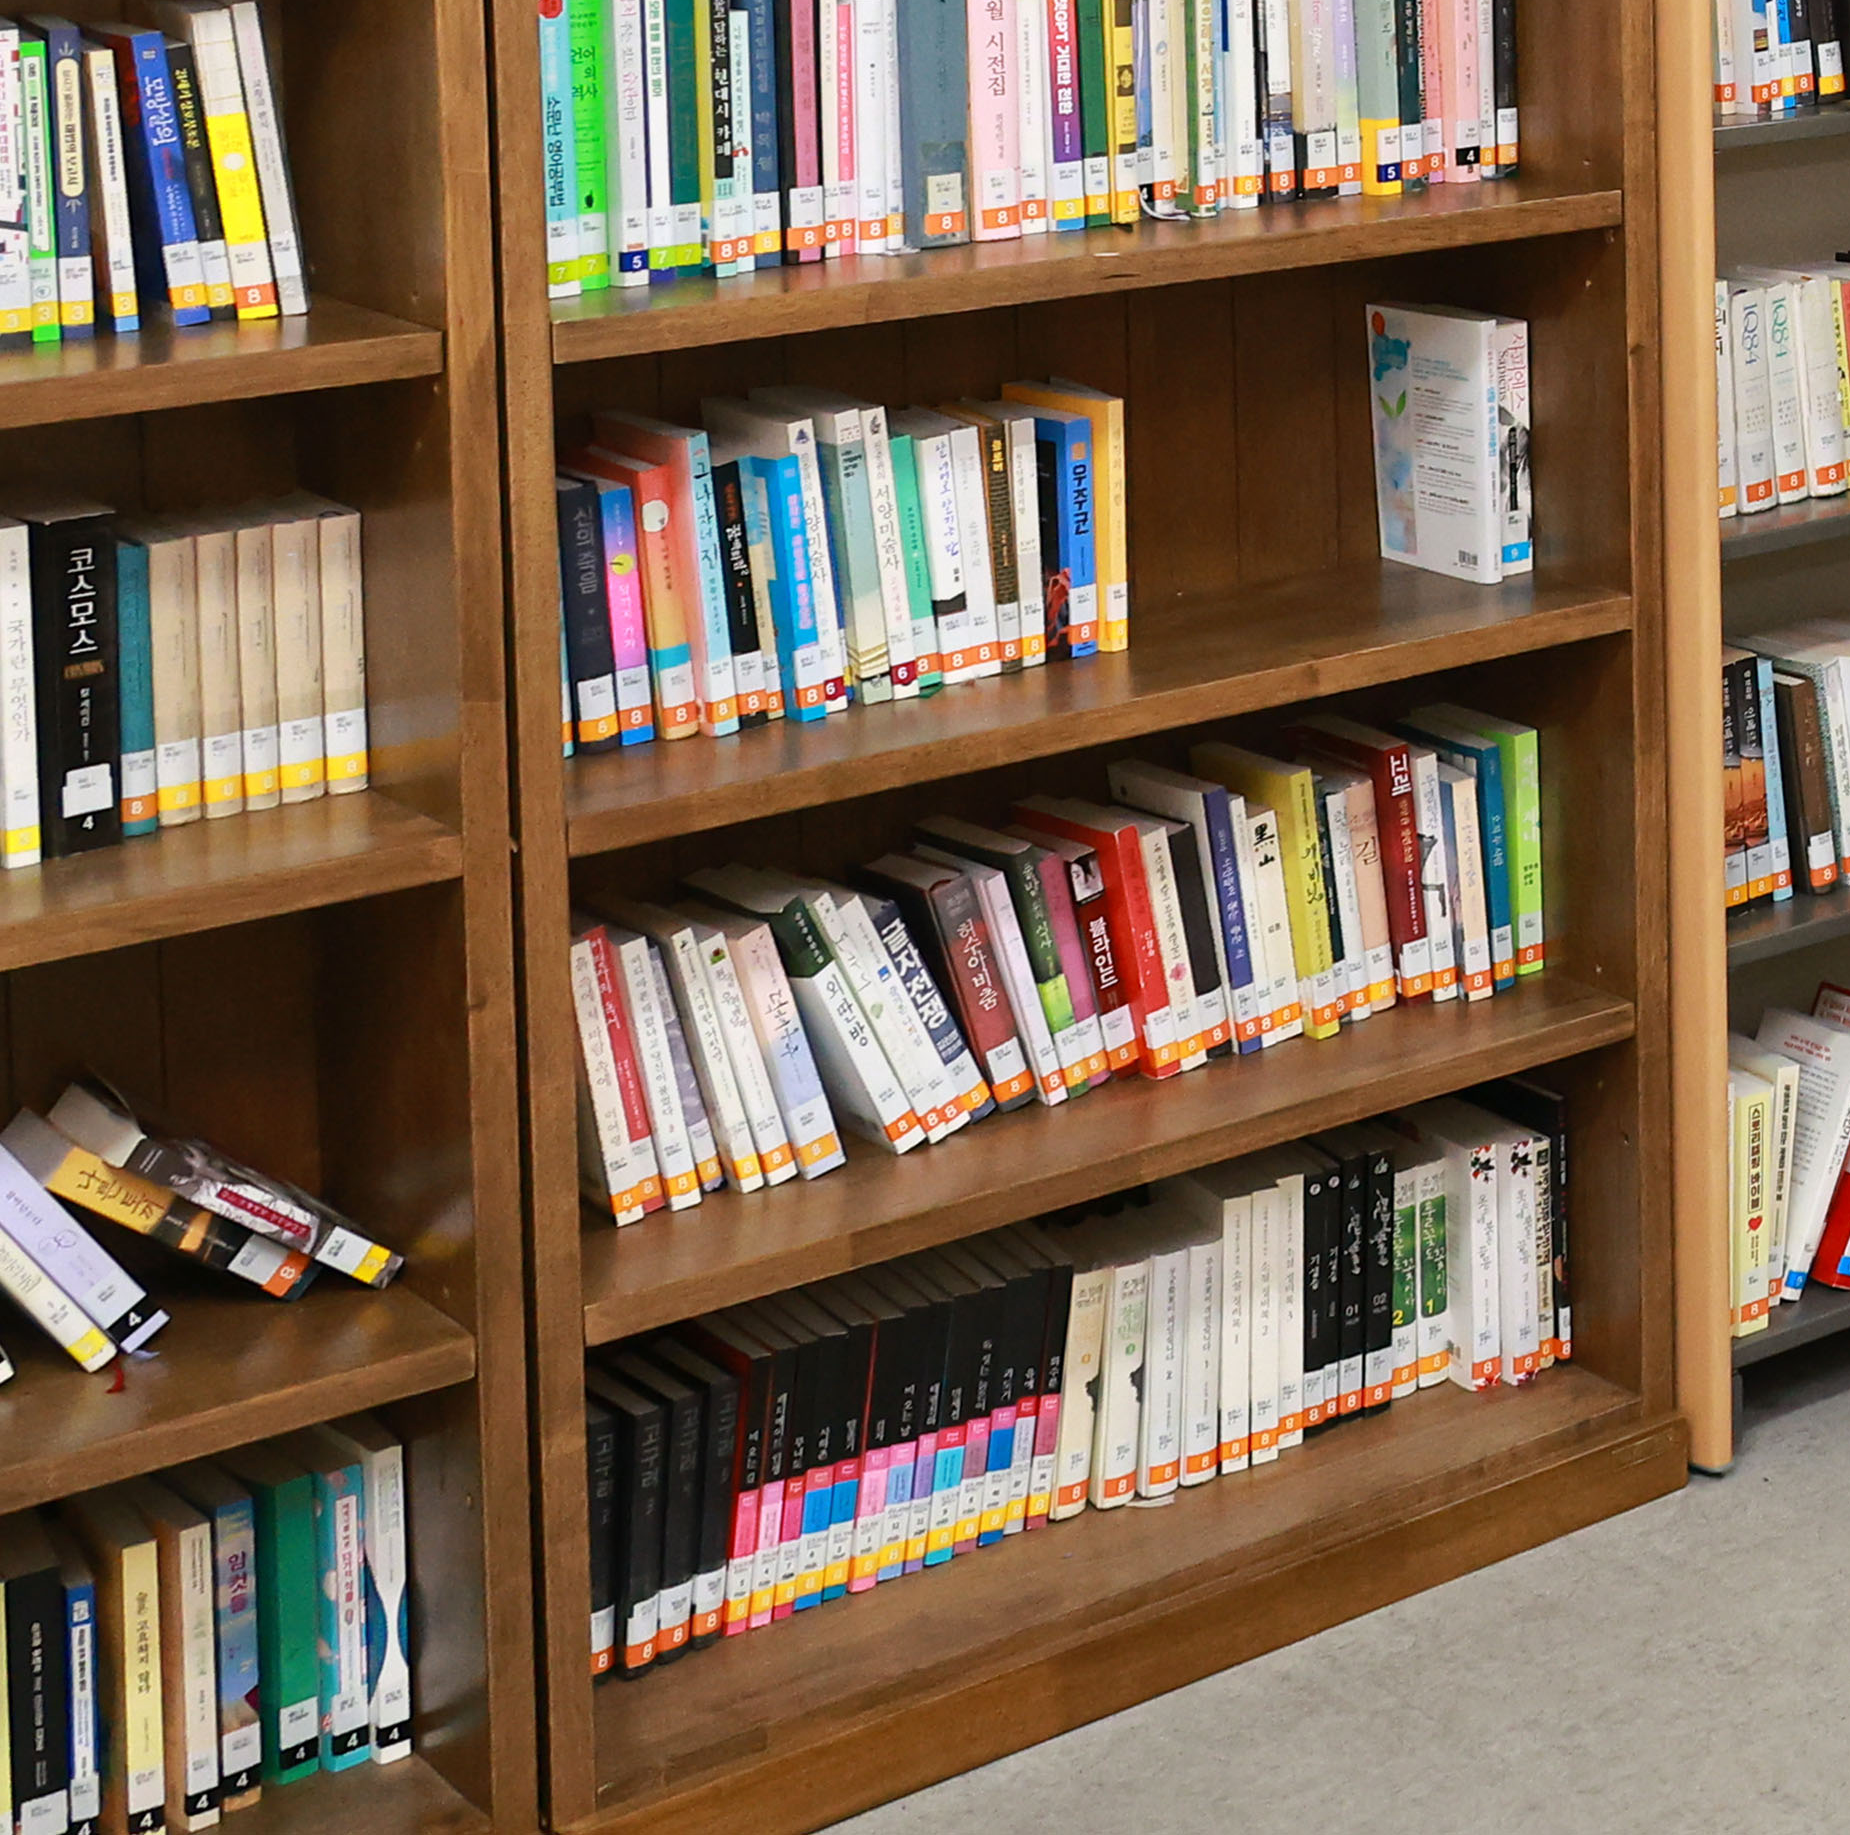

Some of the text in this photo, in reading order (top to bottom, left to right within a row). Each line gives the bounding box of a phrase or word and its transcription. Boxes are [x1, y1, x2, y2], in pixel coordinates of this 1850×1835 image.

[571, 46, 595, 62] 언어
[986, 34, 1006, 97] 시전집
[1055, 44, 1073, 85] 거대한
[584, 67, 596, 81] 의
[571, 85, 598, 101] 역사
[621, 71, 643, 122] 습관이다
[1057, 86, 1073, 115] 전환
[145, 75, 179, 148] 모방살의
[543, 96, 567, 207] 소문난 영어공부법
[1409, 162, 1419, 175] 8
[1205, 188, 1215, 202] 8
[870, 222, 881, 236] 8
[632, 255, 642, 269] 5
[1742, 303, 1758, 365] 1Q84
[1770, 297, 1788, 359] 1Q84
[1512, 332, 1527, 410] 사피엔스
[1828, 467, 1837, 480] 8
[67, 547, 99, 655] 코스모스
[897, 667, 907, 679] 6
[630, 710, 643, 723] 8
[1390, 752, 1413, 797] 고래
[1355, 835, 1378, 867] 길
[956, 918, 998, 1012] 허수아비춤
[1089, 916, 1119, 991] 블라인드
[881, 918, 947, 1030] 글자전쟁
[1473, 974, 1484, 988] 8
[825, 973, 868, 1047] 외딴방
[1119, 1047, 1129, 1060] 8
[1524, 1356, 1533, 1369] 8
[598, 1653, 609, 1668] 8
[235, 1772, 249, 1787] 4
